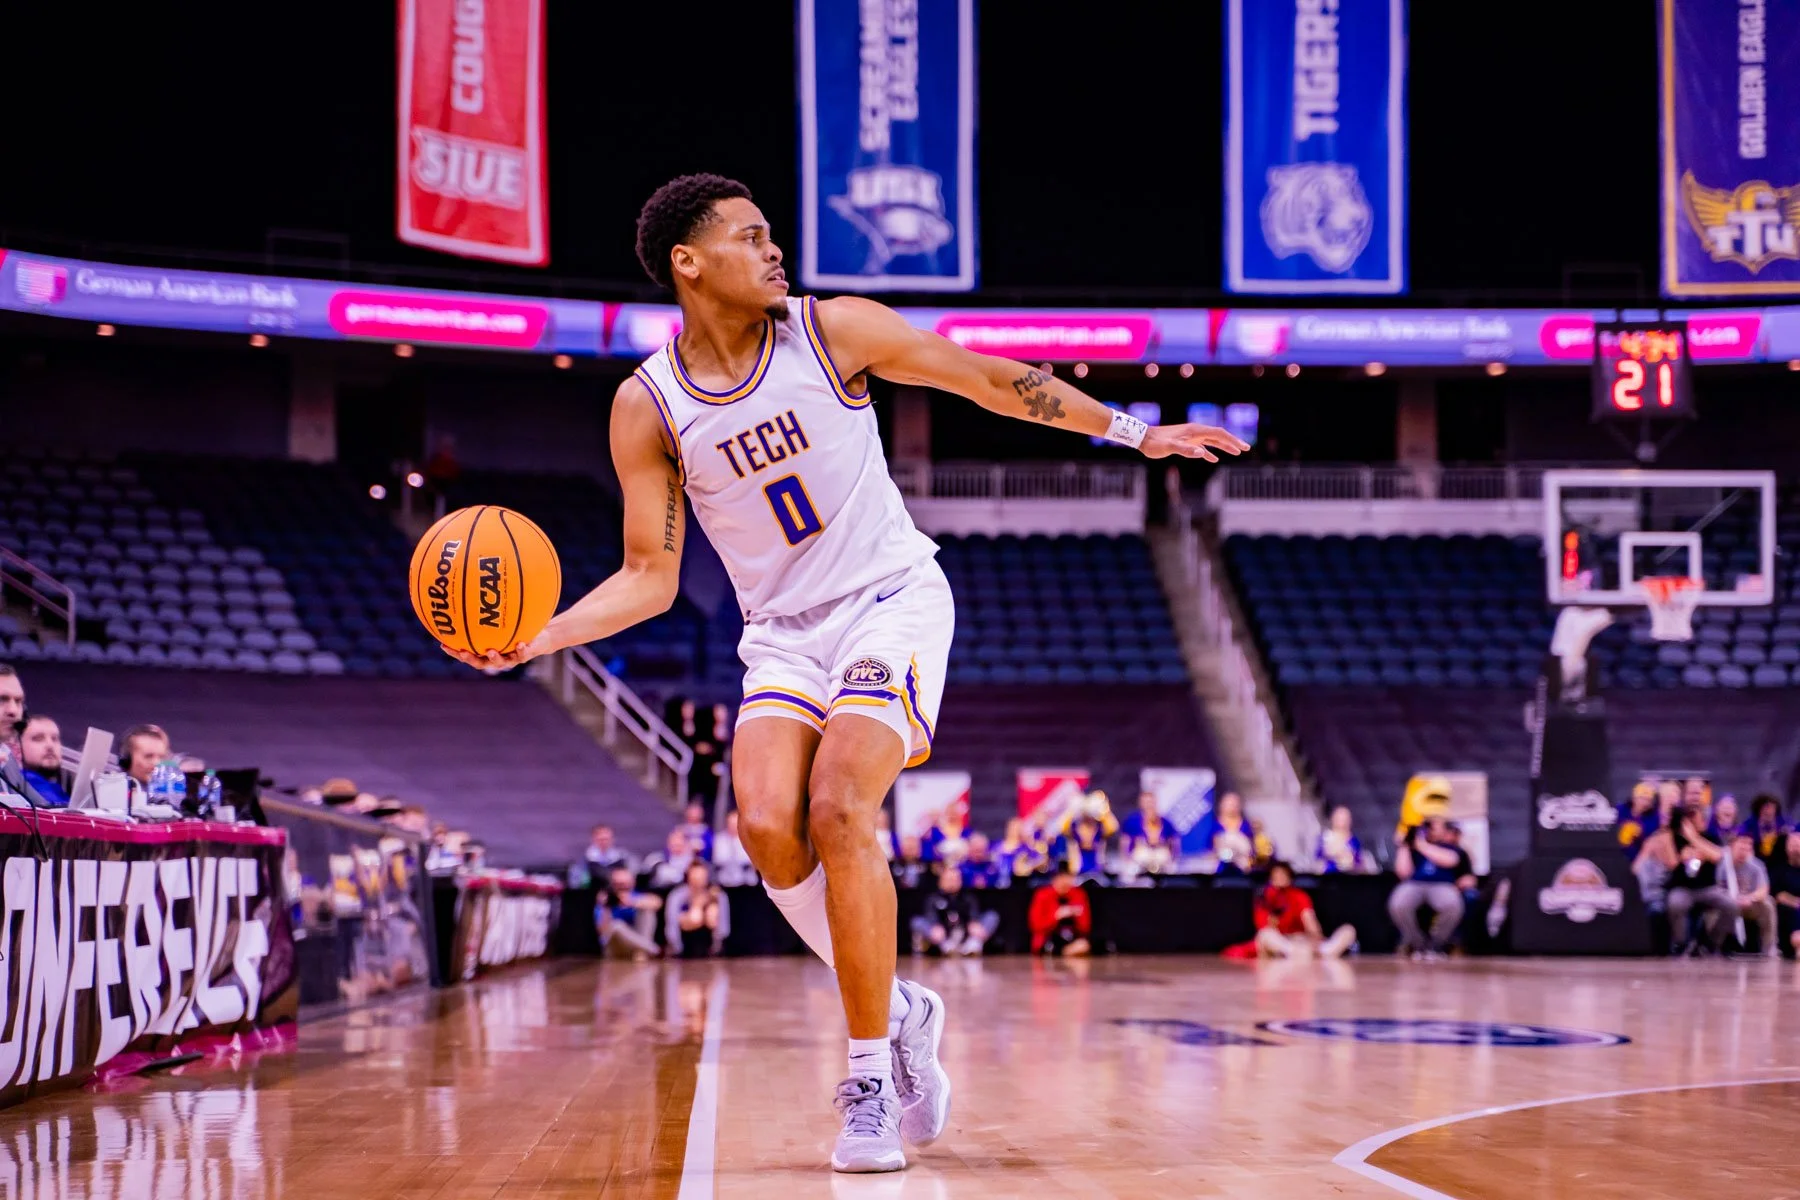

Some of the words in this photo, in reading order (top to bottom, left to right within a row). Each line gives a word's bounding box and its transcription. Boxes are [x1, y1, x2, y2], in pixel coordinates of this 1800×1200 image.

[1738, 65, 1767, 159] GOLDEN
[417, 138, 523, 198] SIUE
[1612, 358, 1674, 410] 21
[715, 409, 811, 479] TECH
[664, 476, 677, 555] DIFFERENT
[762, 472, 825, 547] 0
[428, 540, 461, 636] Wilson
[479, 557, 500, 628] NCAA
[850, 668, 881, 680] OVC
